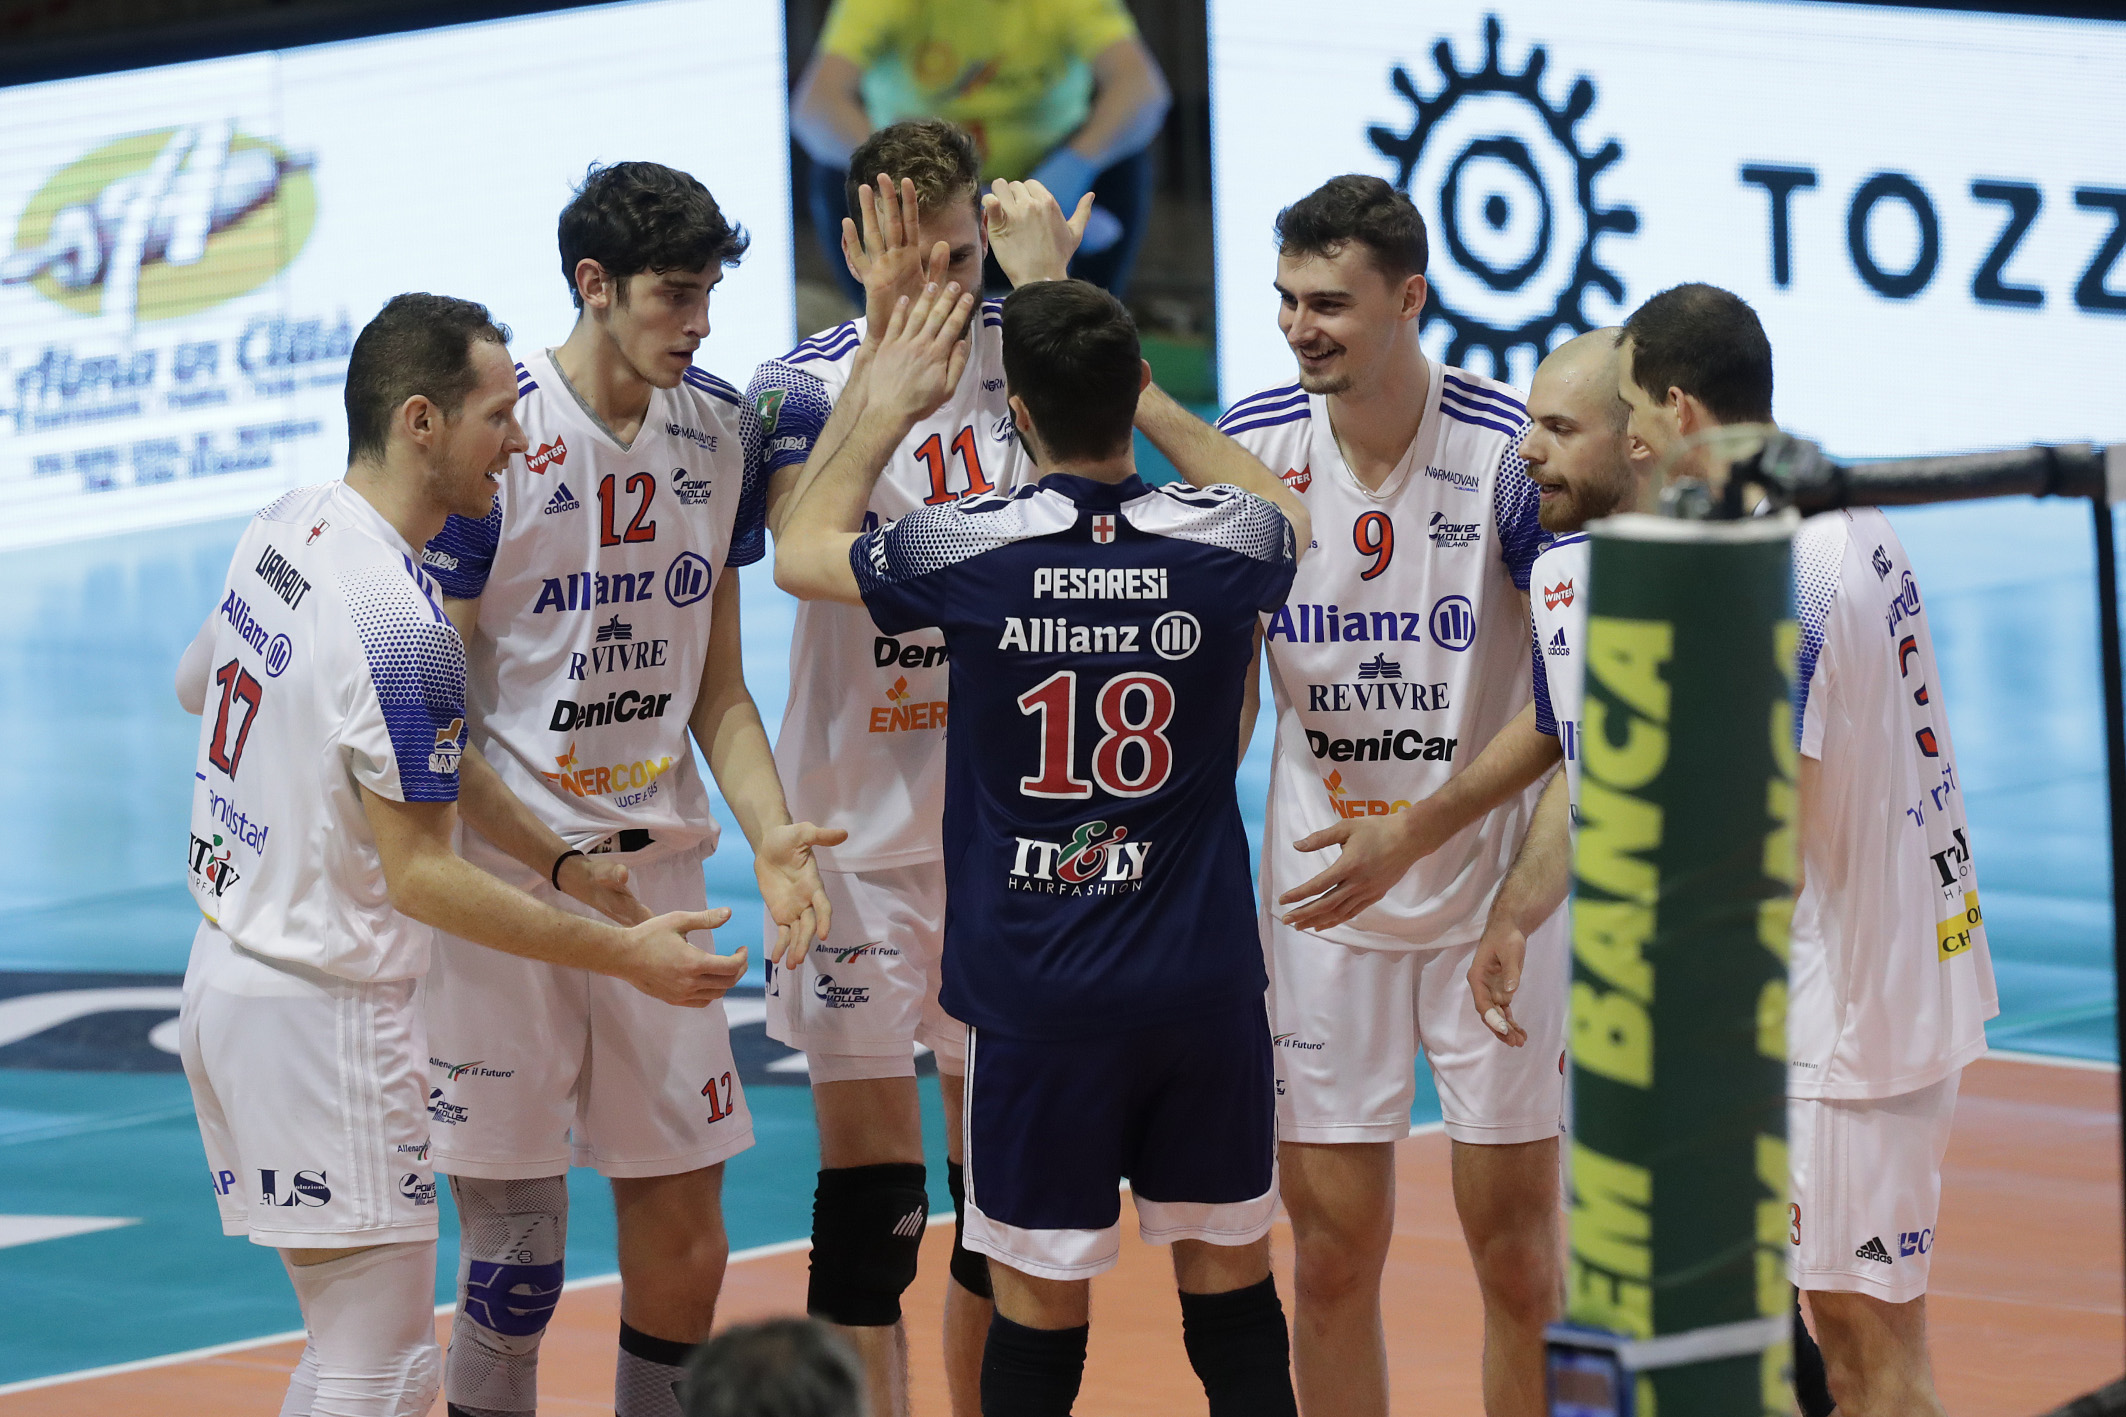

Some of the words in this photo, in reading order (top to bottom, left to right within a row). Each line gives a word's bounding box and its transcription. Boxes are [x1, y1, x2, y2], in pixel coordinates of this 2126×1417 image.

[527, 444, 566, 469] WINTER
[914, 425, 995, 506] 11
[544, 500, 580, 515] adidas
[597, 472, 656, 547] 12
[1353, 510, 1395, 582] 9
[255, 544, 312, 611] URNAUT
[1545, 587, 1573, 602] WINTER
[221, 588, 269, 656] Allianz
[998, 617, 1140, 653] Allianz
[1267, 604, 1421, 644] Allianz
[567, 640, 668, 681] RVIVRE
[1548, 645, 1570, 657] adidas
[549, 690, 672, 732] DeniCar
[1308, 683, 1450, 712] REVIVRE
[208, 657, 263, 783] 17
[1017, 670, 1176, 800] 18
[1305, 728, 1458, 763] DeniCar
[1571, 616, 1675, 1090] BANCA
[1008, 877, 1144, 898] HAIRFASHION
[701, 1071, 736, 1125] 12
[1856, 1249, 1893, 1265] adidas
